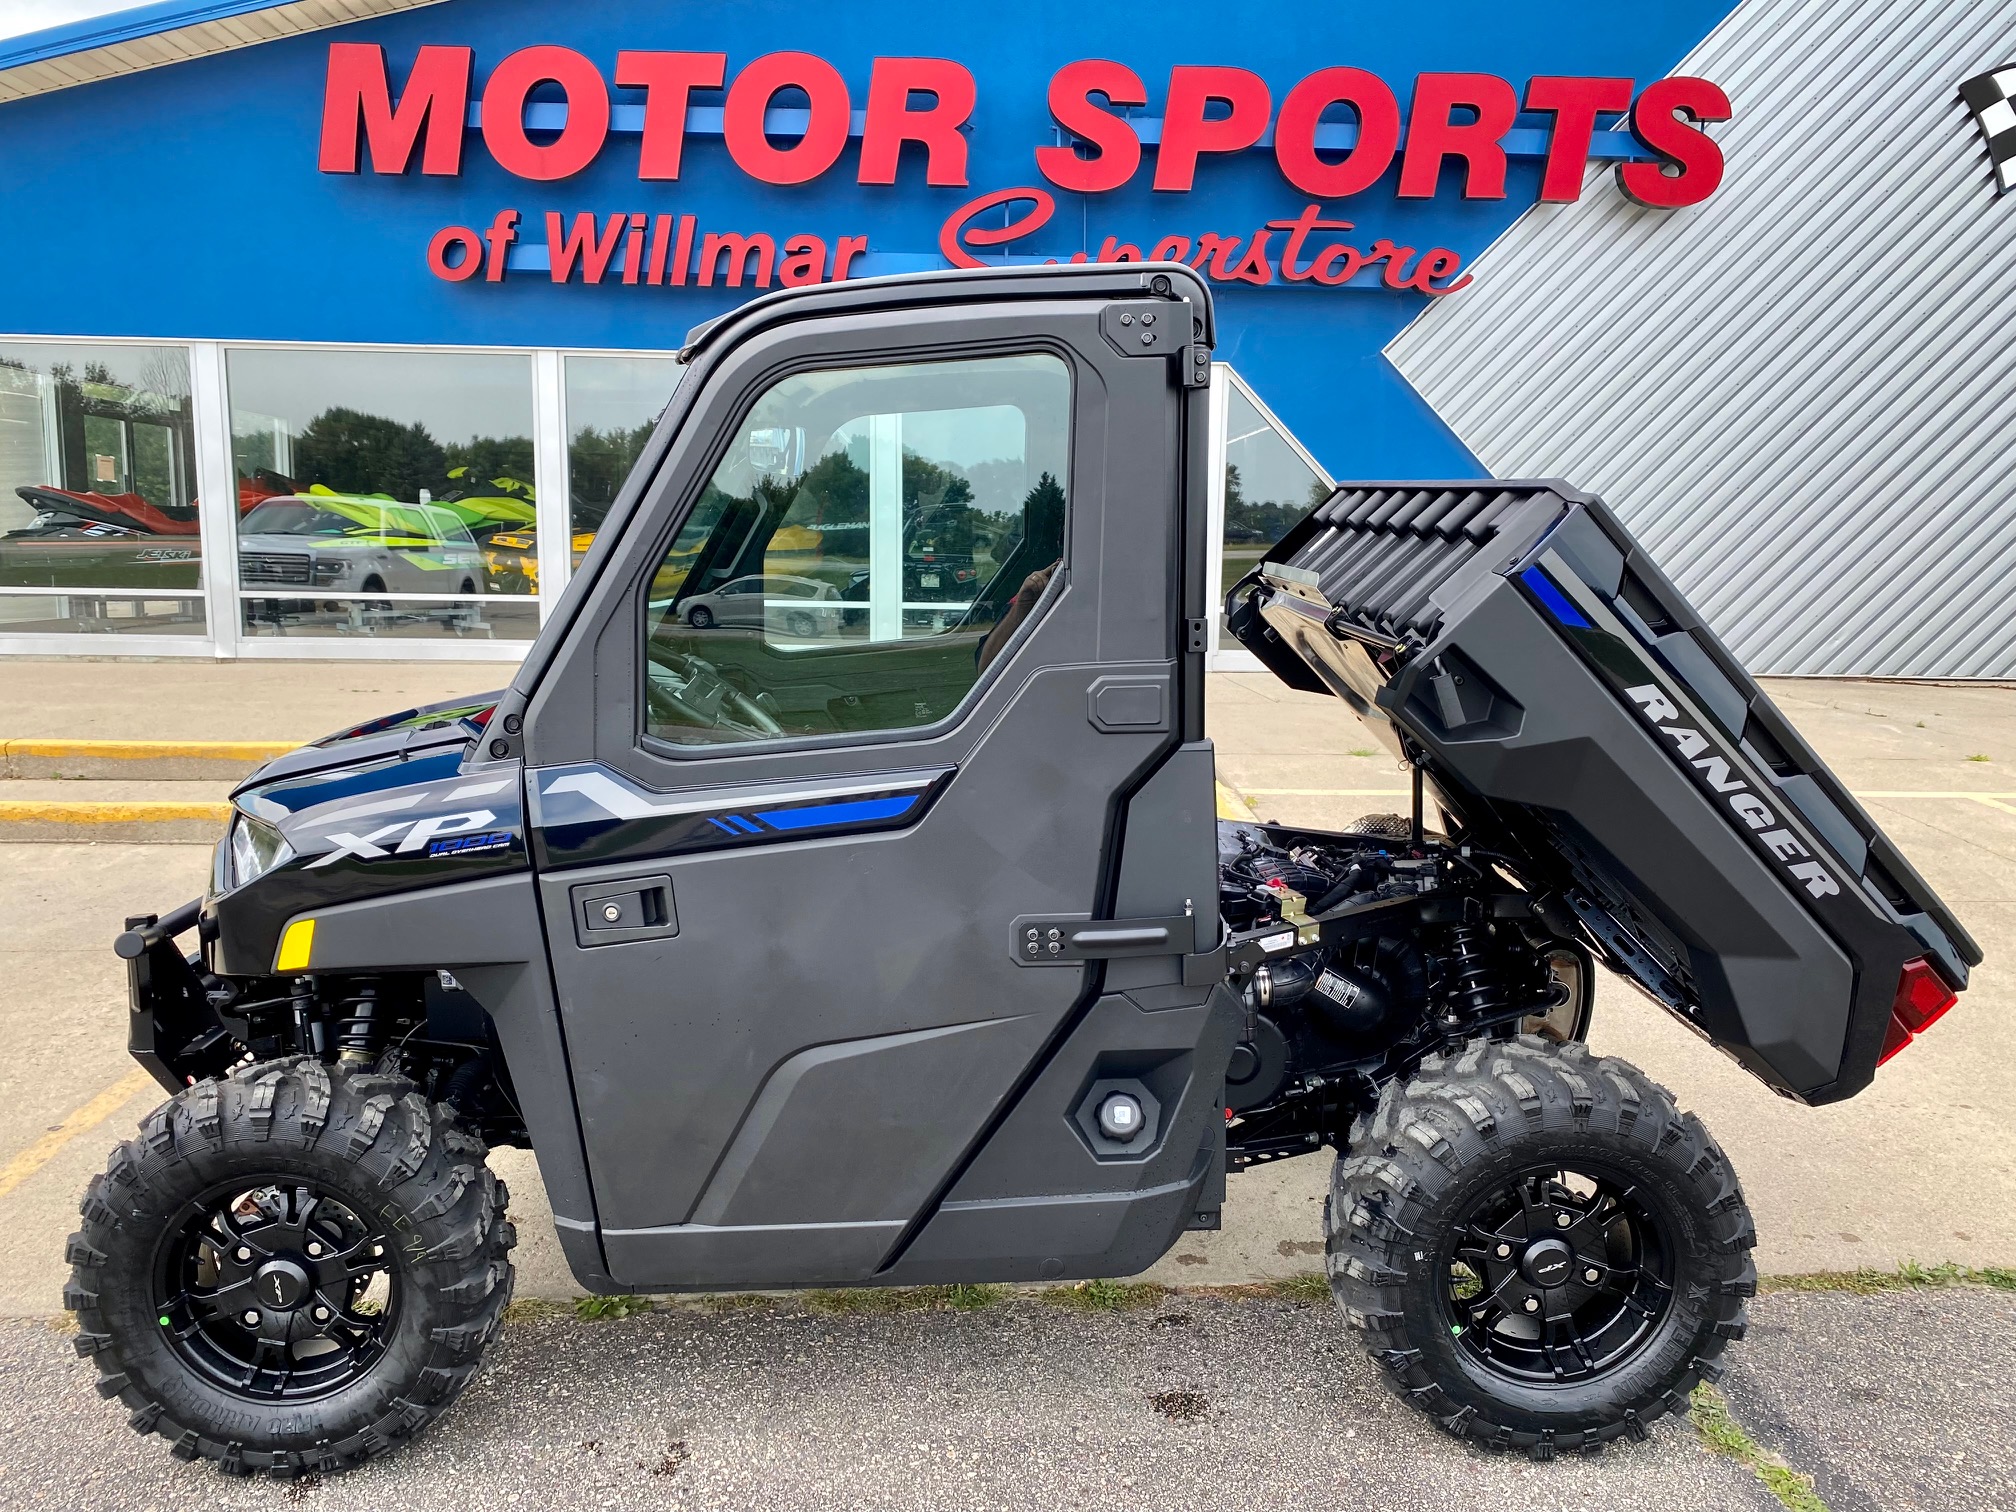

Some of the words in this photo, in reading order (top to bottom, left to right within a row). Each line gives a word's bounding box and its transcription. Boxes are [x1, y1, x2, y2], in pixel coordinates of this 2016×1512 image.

[318, 42, 976, 188] MOTOR
[1035, 58, 1733, 209] SPORTS
[427, 208, 521, 282] of
[545, 212, 868, 288] Willmar
[1624, 683, 1840, 899] RANGER
[301, 809, 497, 870] XP
[430, 831, 513, 852] 1000
[451, 845, 492, 855] OVERHEAD
